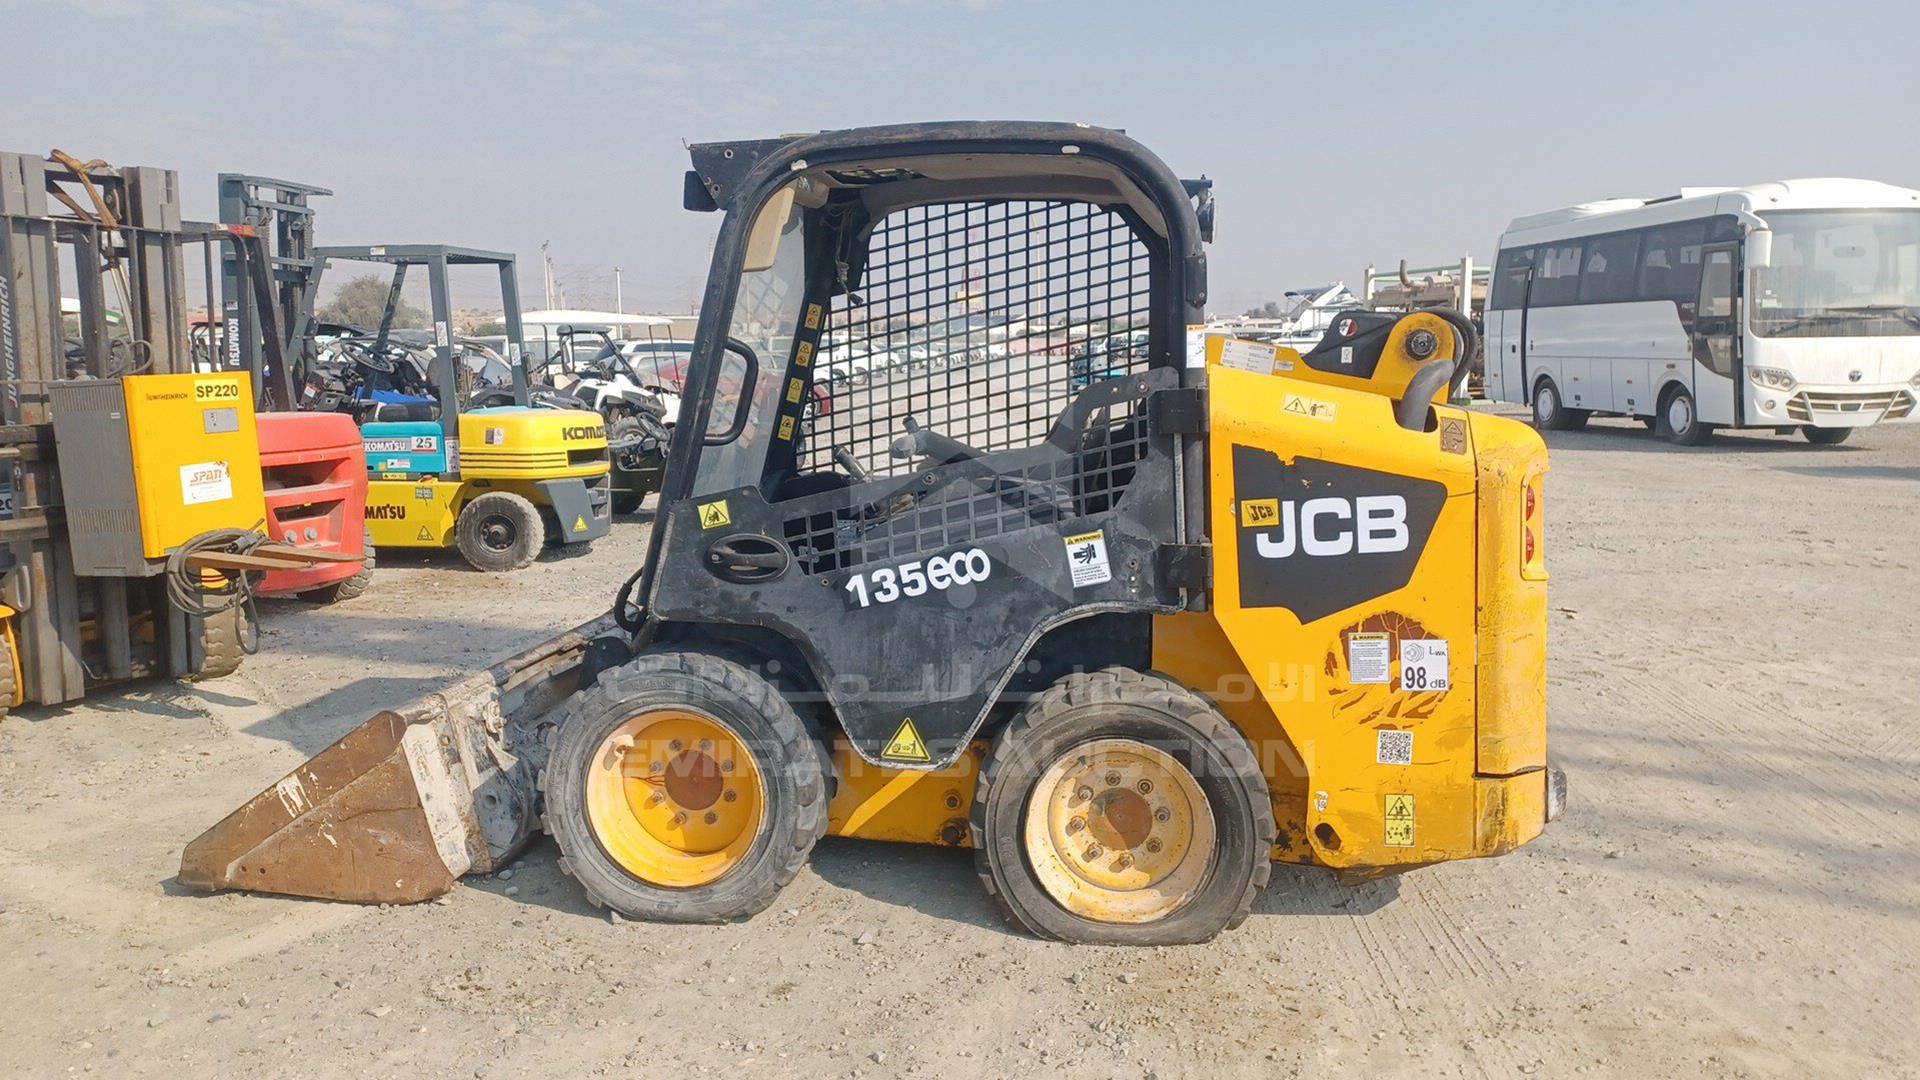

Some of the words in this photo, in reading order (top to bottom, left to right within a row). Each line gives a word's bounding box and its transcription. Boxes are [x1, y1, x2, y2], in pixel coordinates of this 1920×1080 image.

[0, 275, 18, 409] JUNGHEINRICH
[228, 318, 240, 366] KOMATSU
[196, 385, 238, 398] SP220
[364, 441, 406, 452] KOMATSU
[416, 438, 432, 448] 25
[364, 504, 406, 519] MATSU
[1250, 504, 1274, 522] JCB
[1256, 494, 1410, 559] JCB
[845, 548, 991, 608] 135eco
[1405, 667, 1427, 689] 98
[1430, 680, 1446, 689] dB
